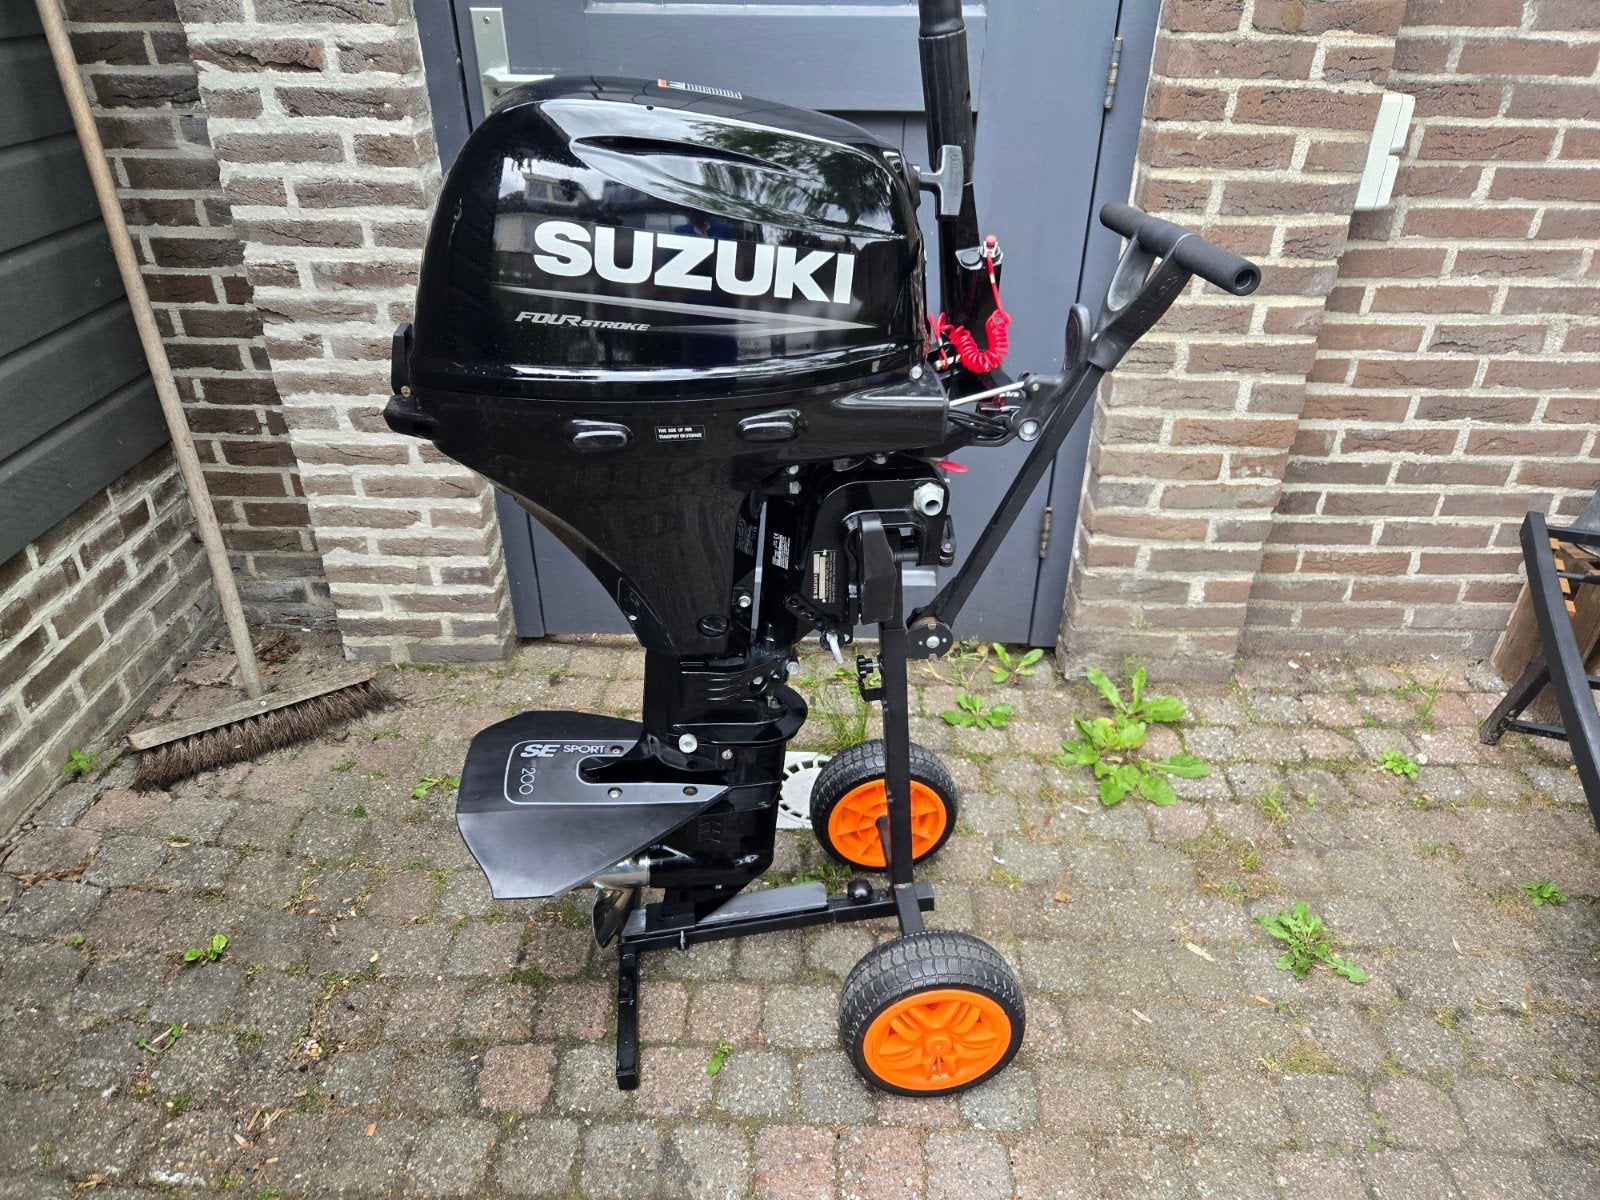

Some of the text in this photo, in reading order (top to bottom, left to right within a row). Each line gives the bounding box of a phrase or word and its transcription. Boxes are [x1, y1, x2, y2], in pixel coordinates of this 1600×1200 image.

[533, 220, 855, 304] SUZUKI
[515, 311, 651, 332] FOUR STROKE
[520, 744, 606, 758] SE SPORT
[519, 767, 536, 795] 200
